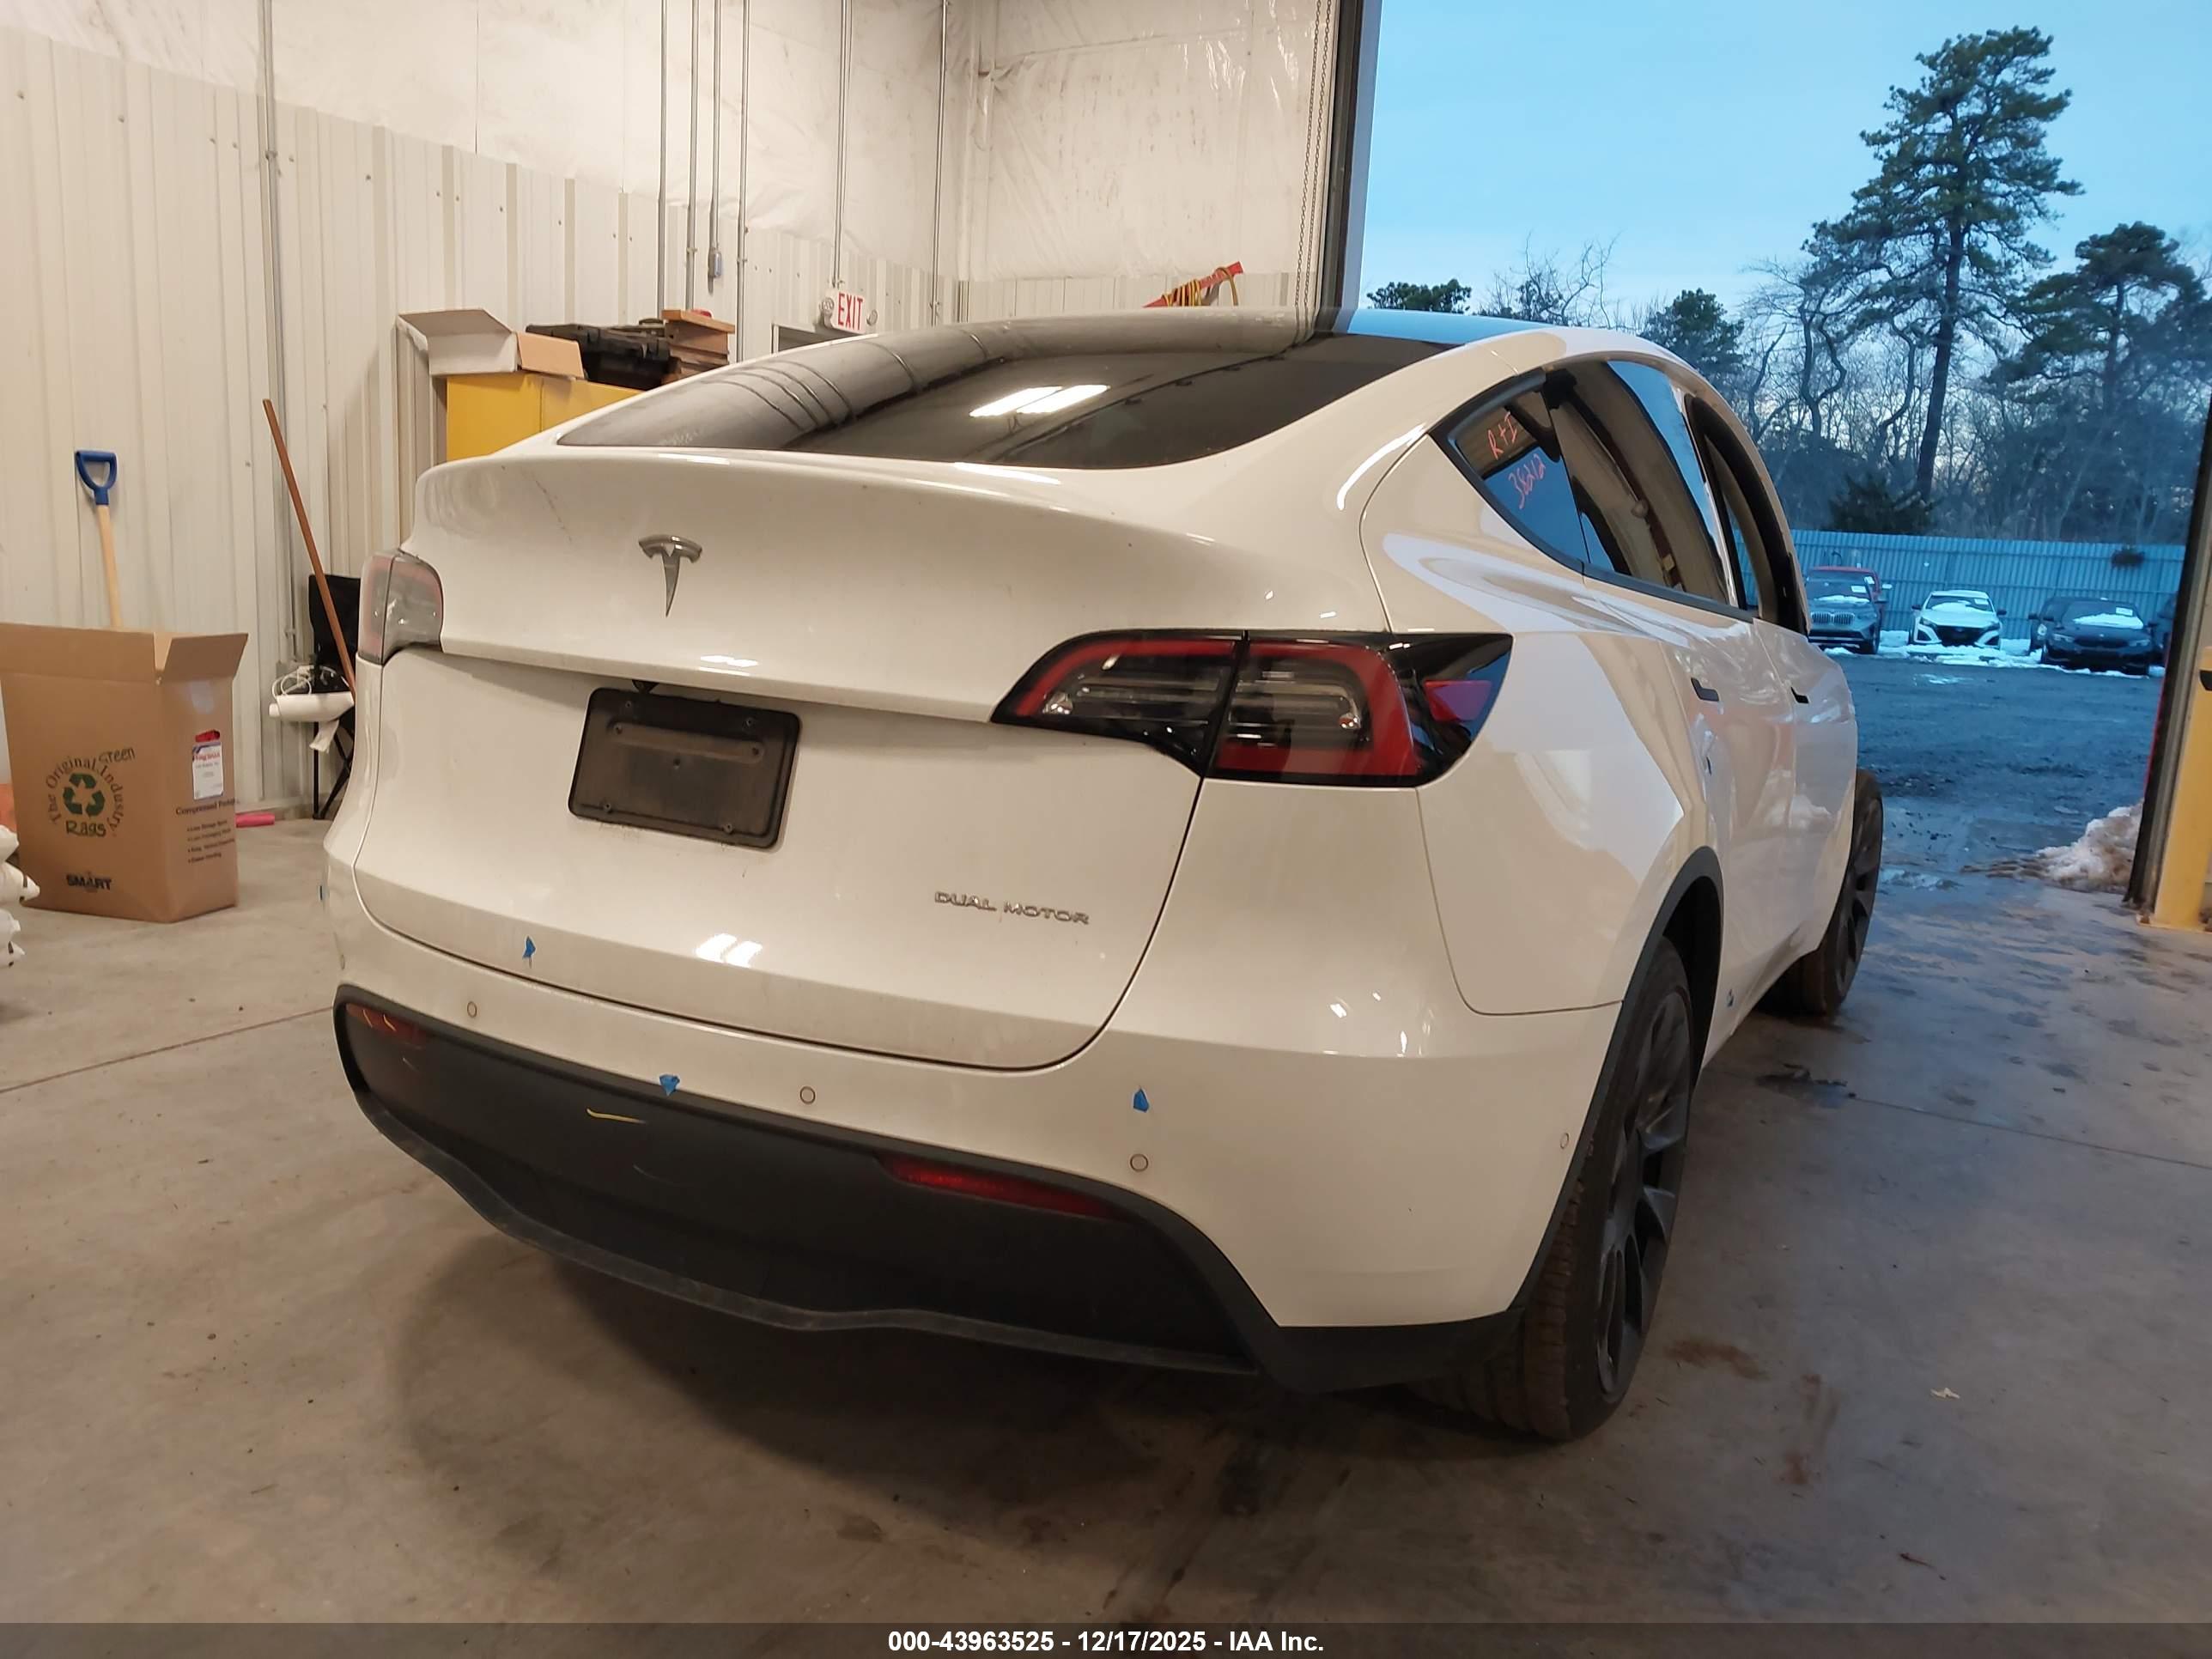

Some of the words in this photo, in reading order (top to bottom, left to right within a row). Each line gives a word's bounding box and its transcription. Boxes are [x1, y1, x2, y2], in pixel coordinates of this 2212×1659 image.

[838, 292, 863, 331] EXIT
[46, 757, 97, 789] Original
[47, 793, 62, 824] The
[100, 765, 124, 832] Industry
[65, 820, 106, 837] Rags
[66, 873, 112, 890] SMART
[935, 891, 997, 912] DUAL
[1003, 902, 1089, 925] MOTOR
